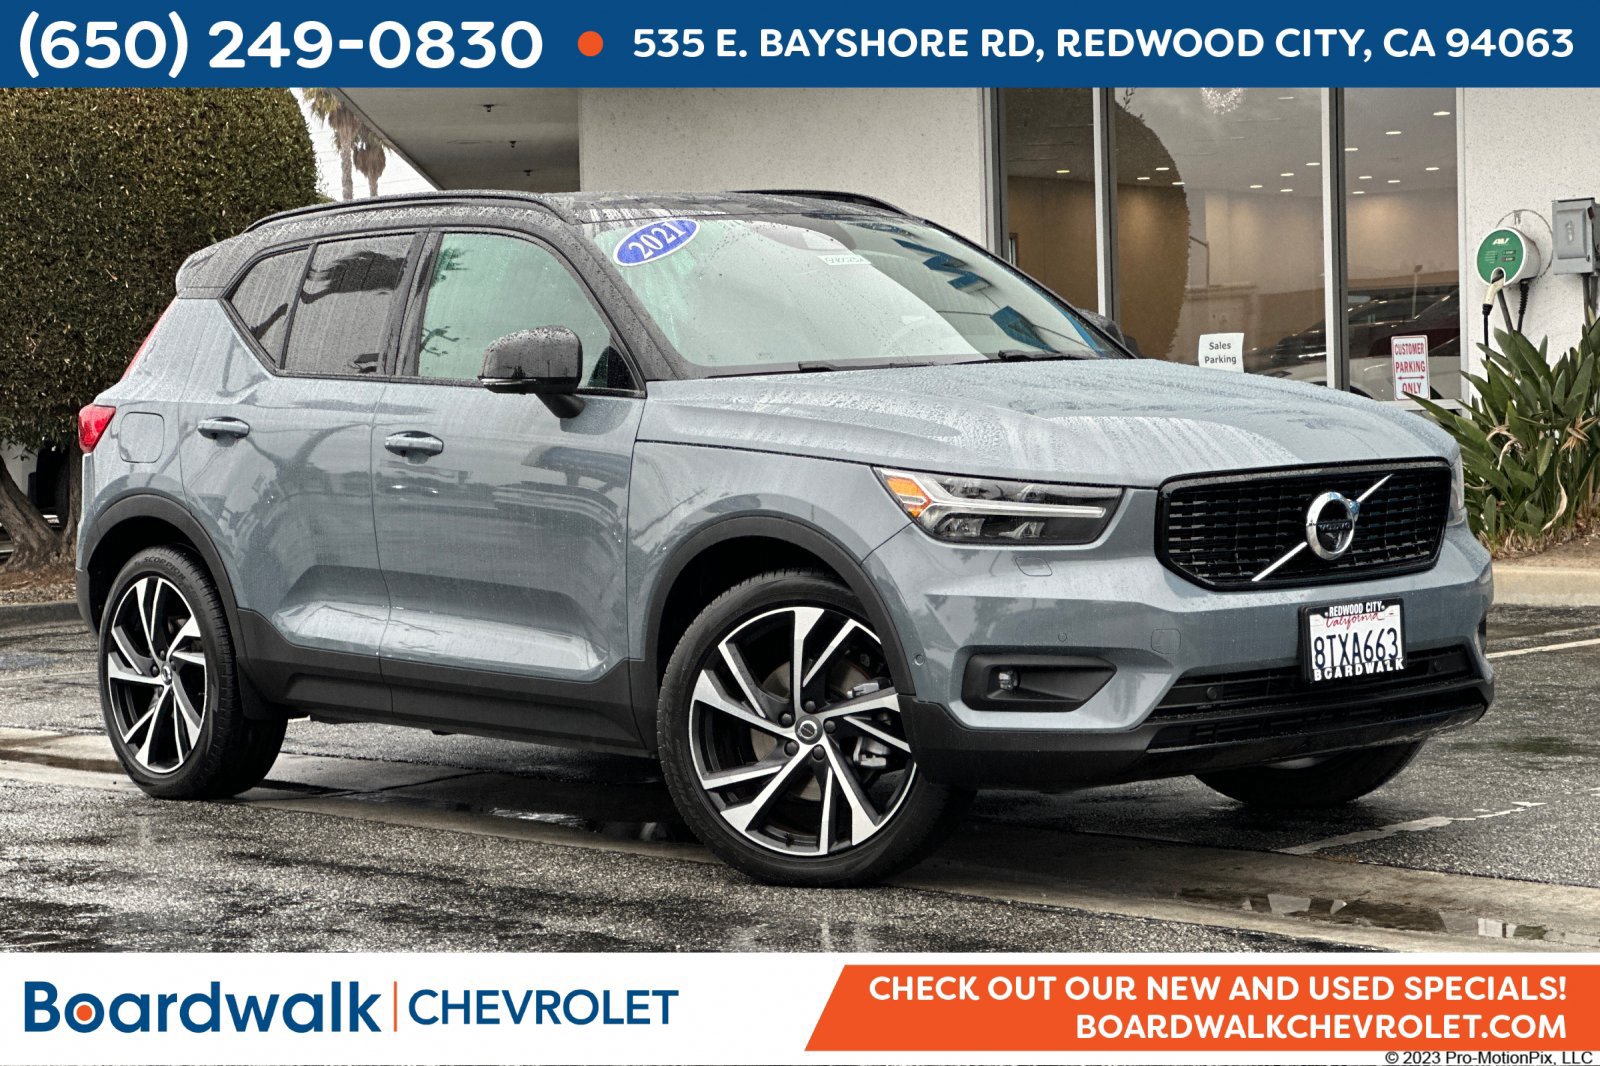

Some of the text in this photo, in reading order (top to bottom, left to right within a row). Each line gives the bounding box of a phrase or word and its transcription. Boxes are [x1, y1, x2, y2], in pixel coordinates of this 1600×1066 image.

[628, 221, 686, 260] 2021
[1208, 341, 1232, 351] Sales
[1394, 342, 1425, 355] CUSTOMER
[1204, 355, 1237, 365] Parking
[1395, 360, 1426, 373] PARKING
[1402, 382, 1422, 395] ONLY
[144, 556, 187, 580] SCORPION
[1329, 600, 1383, 617] REDWOOD CITY
[1325, 612, 1385, 630] California
[1314, 627, 1399, 669] 8TXA663
[1313, 658, 1404, 681] BOARDWALK
